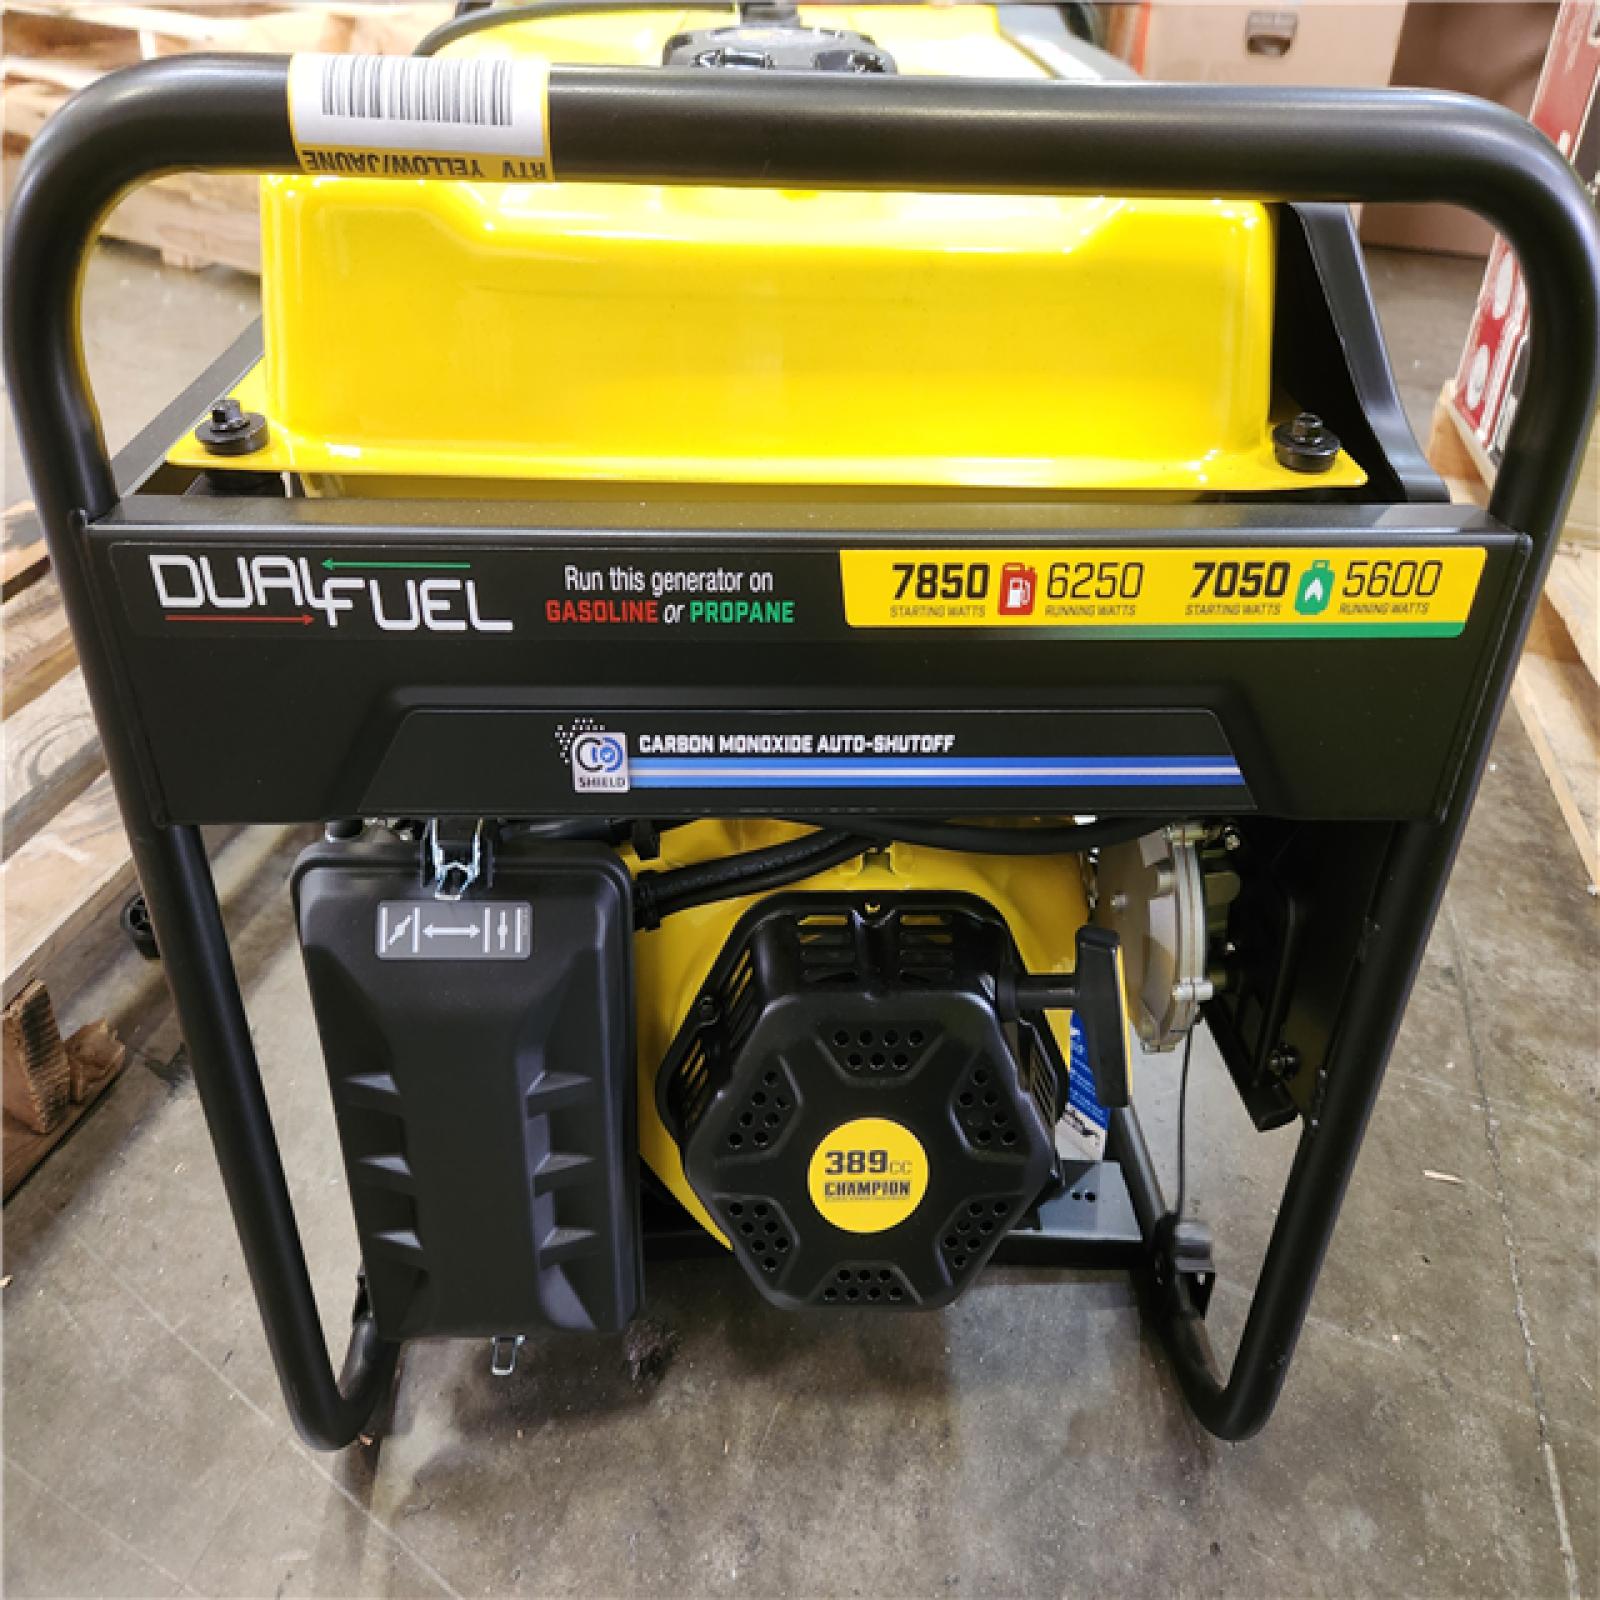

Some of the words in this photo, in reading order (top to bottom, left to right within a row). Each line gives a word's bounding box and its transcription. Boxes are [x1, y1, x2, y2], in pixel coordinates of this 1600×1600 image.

[302, 151, 485, 178] YELLOW/JAUNE
[564, 564, 603, 591] Run
[608, 565, 646, 592] this
[651, 567, 744, 598] generator
[749, 571, 774, 593] on
[892, 562, 990, 600] 7850
[1046, 562, 1144, 599] 6250
[1190, 561, 1291, 598] 7050
[1342, 560, 1443, 598] 5600
[149, 554, 352, 608] DUAL
[321, 577, 514, 631] FUEL
[545, 600, 659, 623] GASOLINE
[664, 604, 685, 623] or
[690, 601, 795, 623] PROPANE
[890, 605, 945, 618] STARTING
[947, 605, 986, 617] WATTS
[1045, 604, 1095, 617] RUNNING
[1096, 604, 1136, 616] WATTS
[1185, 603, 1241, 616] STARTING
[1242, 603, 1281, 615] WATTS
[1338, 602, 1389, 615] RUNNING
[1390, 602, 1430, 615] WATTS
[639, 734, 713, 753] CARBON
[719, 734, 813, 753] MONOXIDE
[817, 734, 956, 753] AUTO-SHUTOFF
[578, 776, 626, 788] SHIELD
[824, 1180, 911, 1196] CHAMPION
